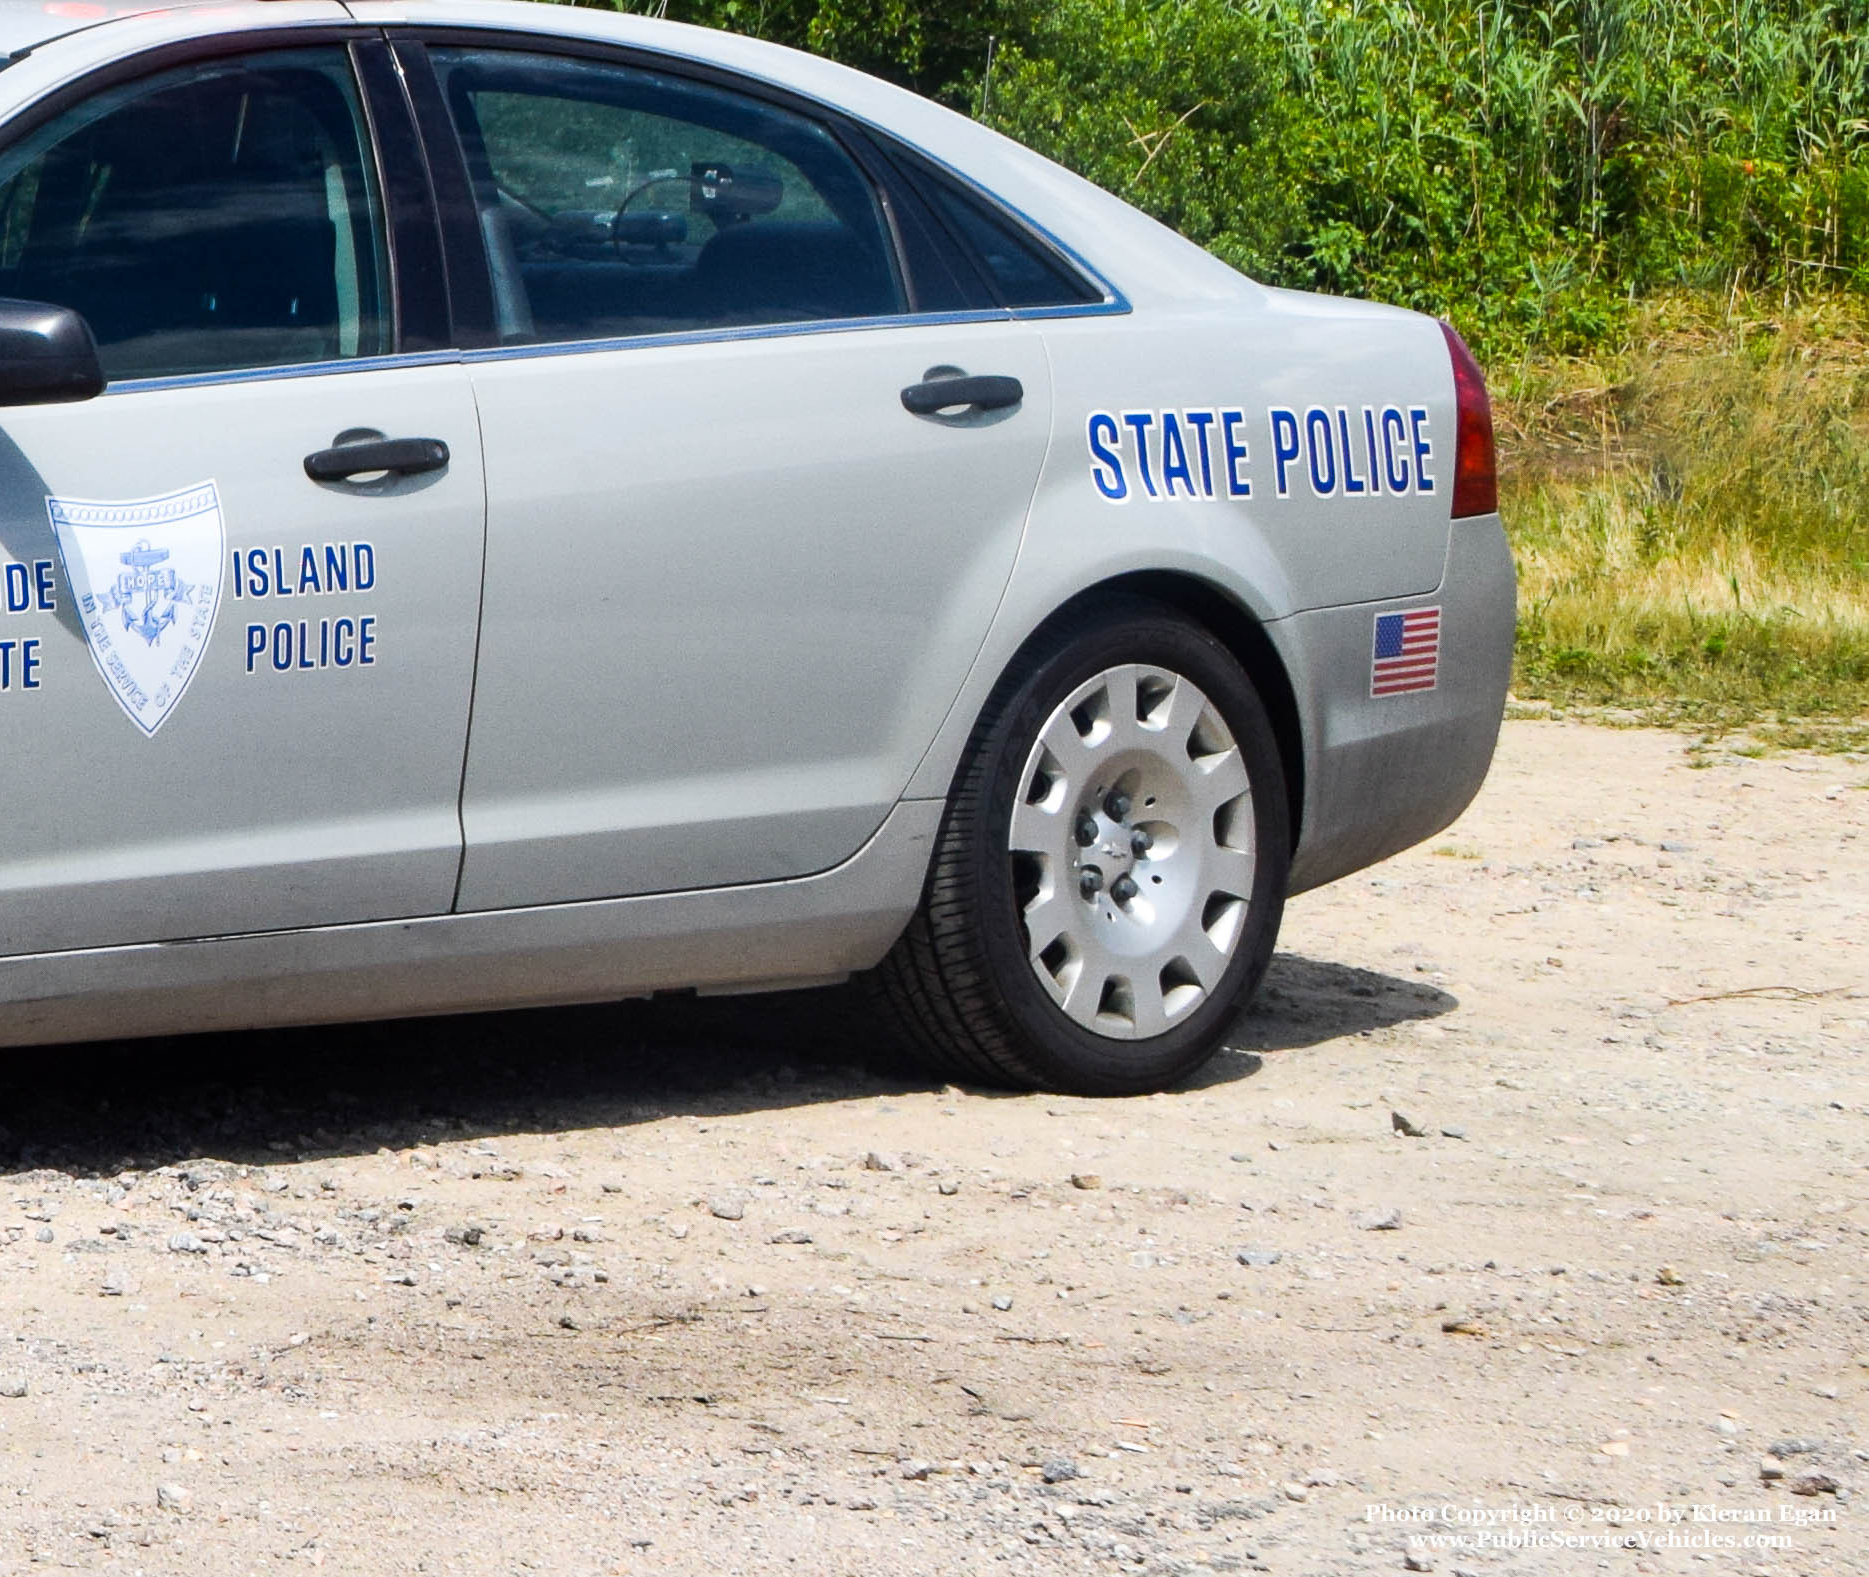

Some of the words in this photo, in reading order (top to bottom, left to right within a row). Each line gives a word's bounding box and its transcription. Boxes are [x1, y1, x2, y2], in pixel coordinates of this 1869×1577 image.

[1088, 411, 1250, 500] STATE
[1270, 408, 1434, 493] POLICE
[127, 573, 166, 589] HOPE
[233, 543, 376, 596] ISLAND
[247, 617, 375, 670] POLICE
